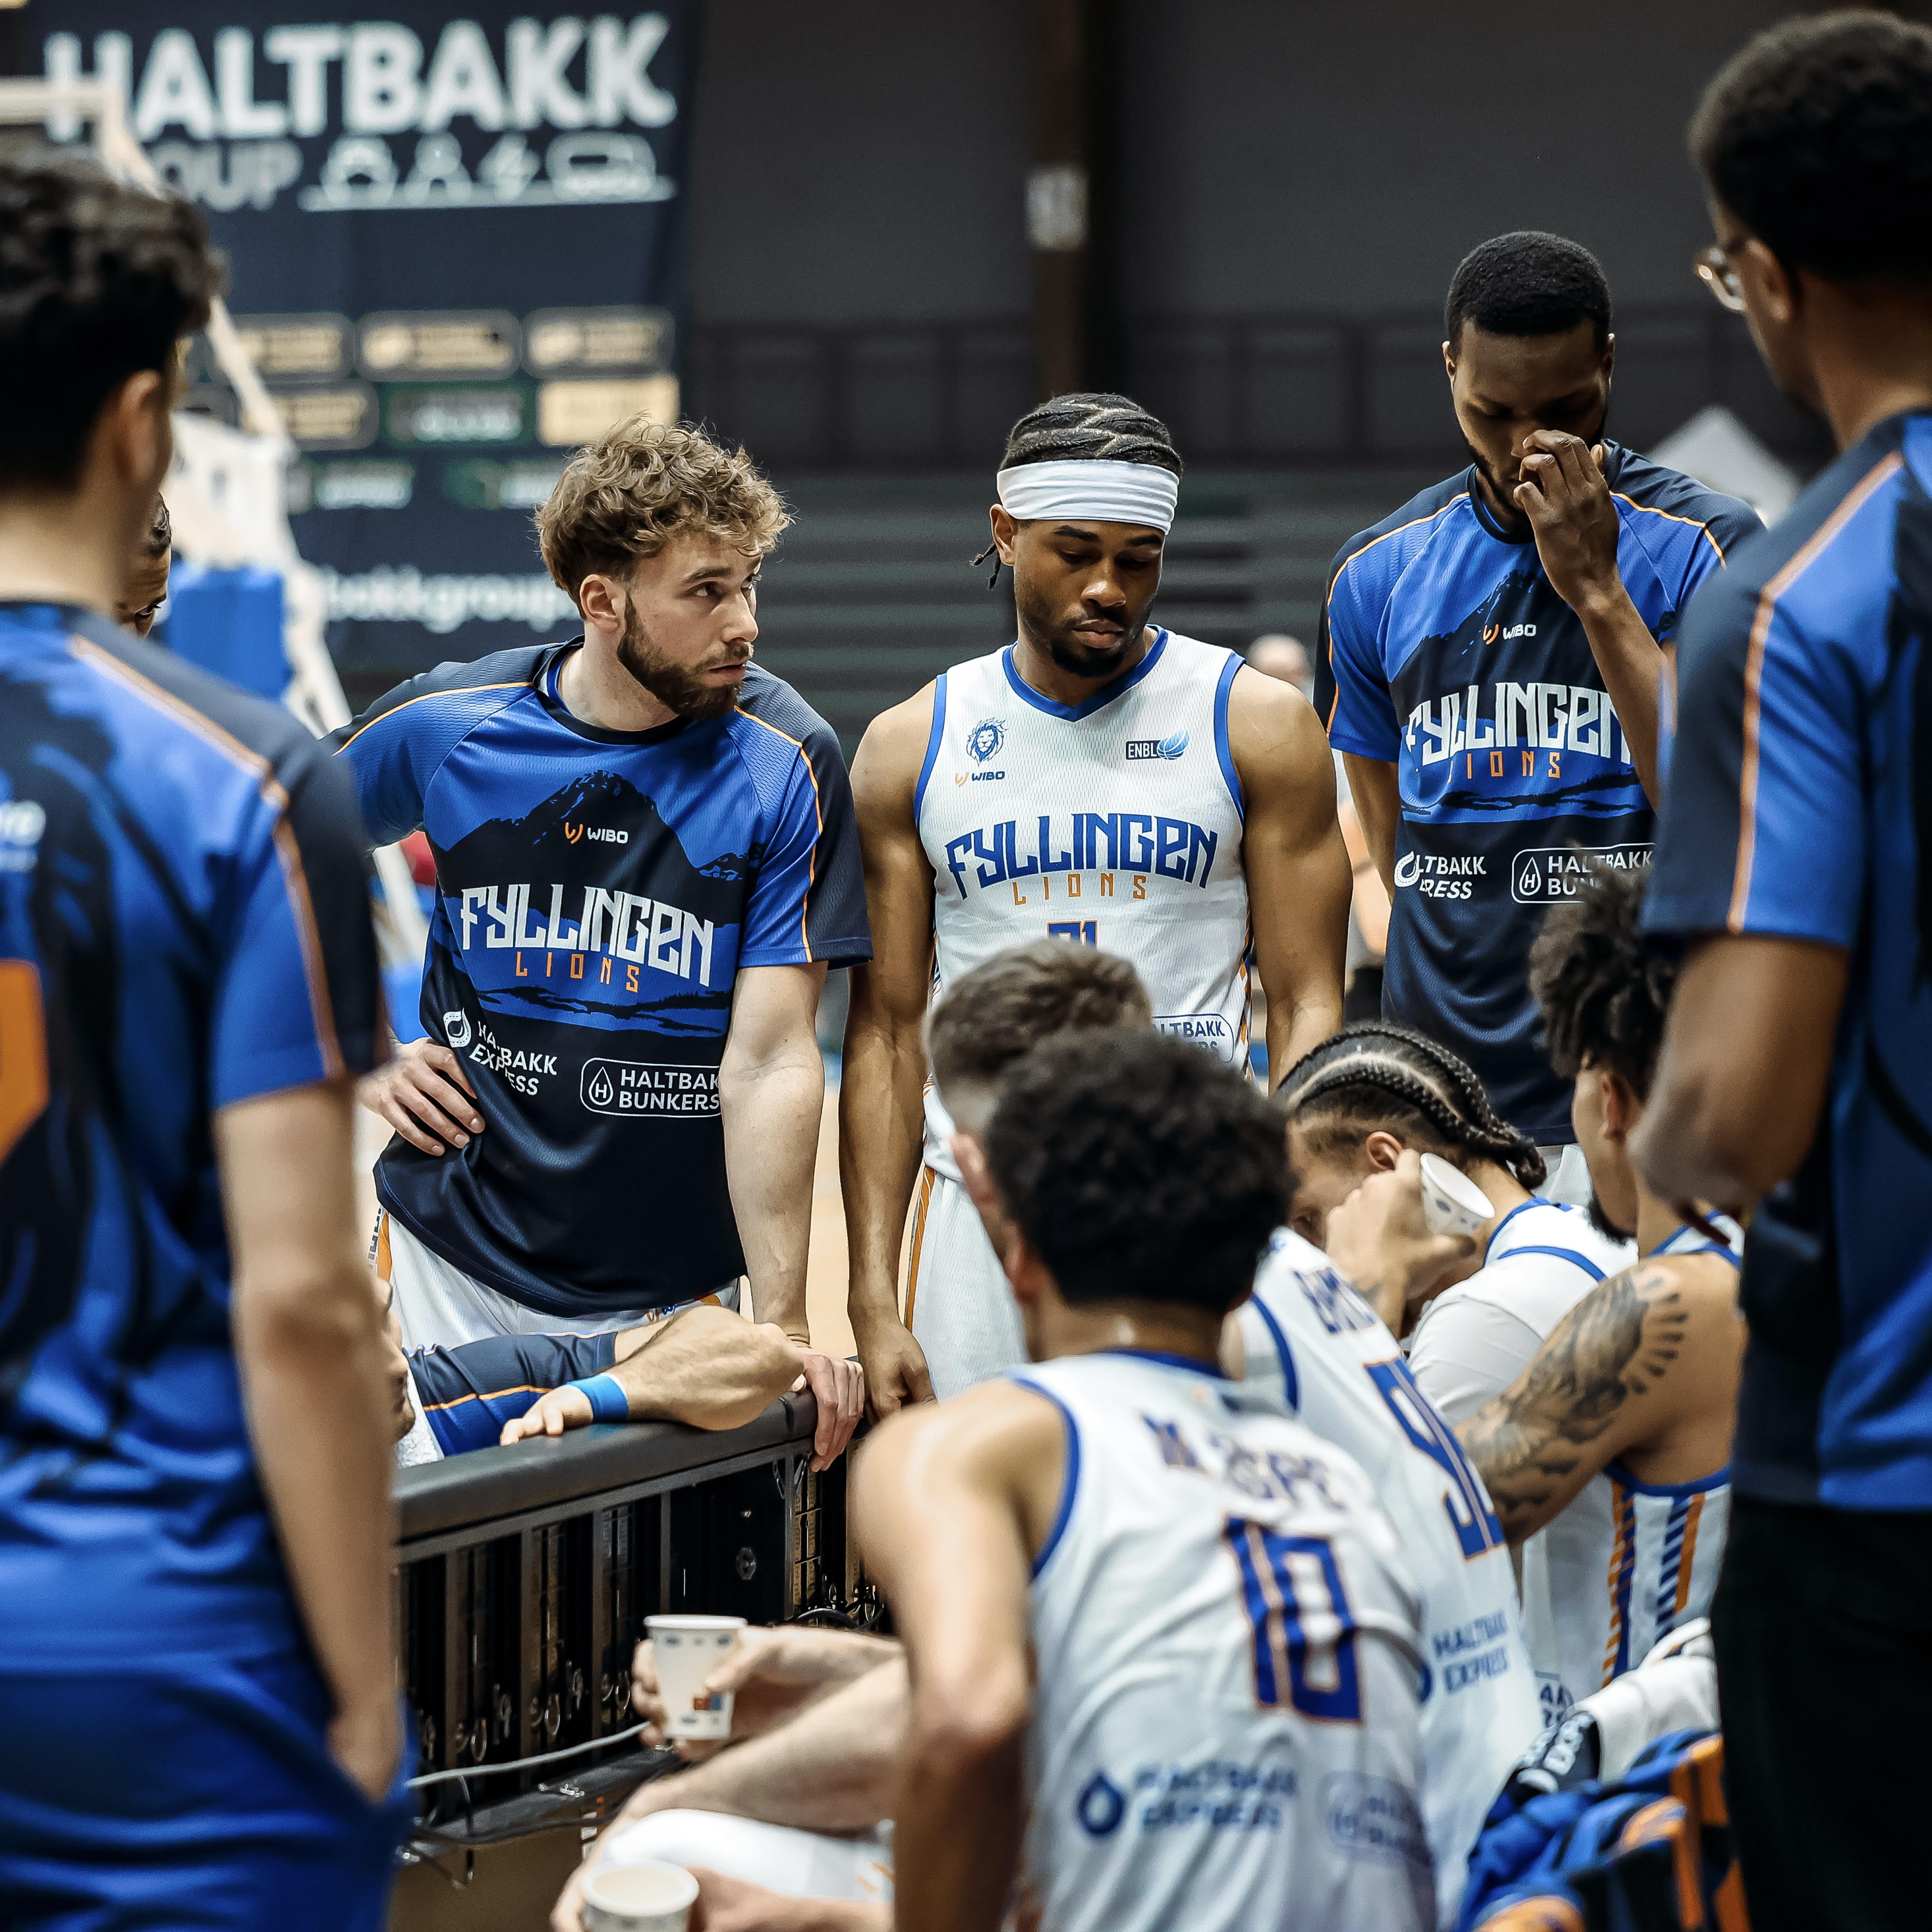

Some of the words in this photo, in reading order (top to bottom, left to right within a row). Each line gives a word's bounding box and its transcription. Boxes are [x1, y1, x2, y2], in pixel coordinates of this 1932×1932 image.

[43, 11, 677, 143] HALTBAKK
[146, 139, 304, 213] OUP
[1503, 624, 1536, 639] WIBO
[1128, 742, 1158, 758] ENBL
[971, 770, 1005, 781] WIBO
[587, 827, 628, 844] WIBO
[944, 813, 1218, 900] FYLLINGEN
[1416, 854, 1487, 875] LTBAKK
[1012, 873, 1147, 906] LIONS
[461, 883, 714, 988] FYLLINGEN
[516, 951, 640, 993] LIONS
[1152, 1020, 1226, 1037] TBAKK
[477, 1020, 557, 1076] HABAKK
[621, 1069, 719, 1090] HALTBAK
[619, 1090, 720, 1110] BUNKERS
[1224, 1511, 1366, 1725] 10
